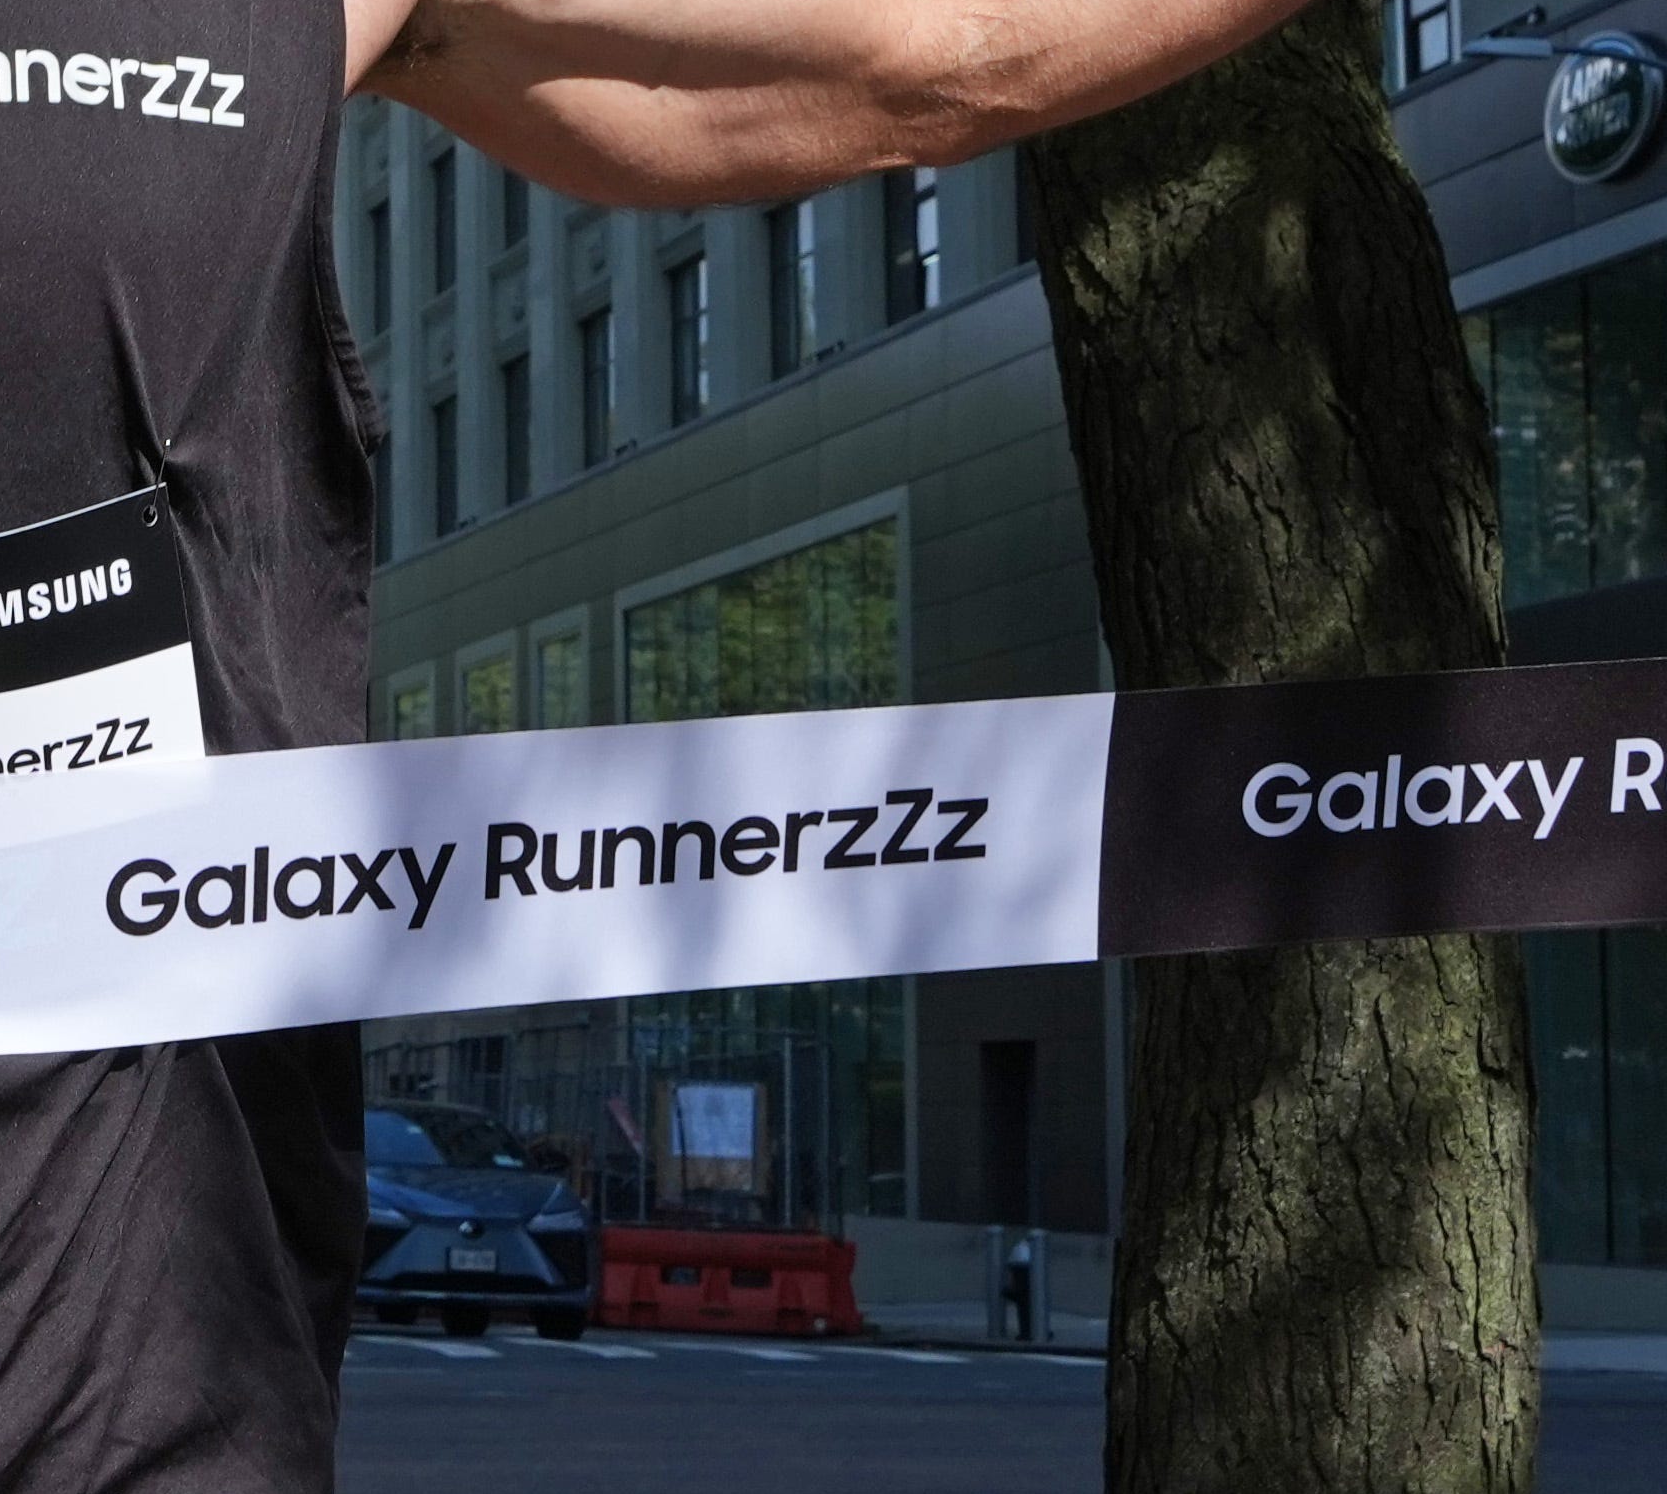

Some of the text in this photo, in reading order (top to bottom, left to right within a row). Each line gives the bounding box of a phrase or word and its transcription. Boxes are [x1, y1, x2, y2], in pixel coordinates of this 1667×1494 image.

[1242, 755, 1584, 840] Galaxy
[105, 787, 989, 937] Galaxy RunnerzZz
